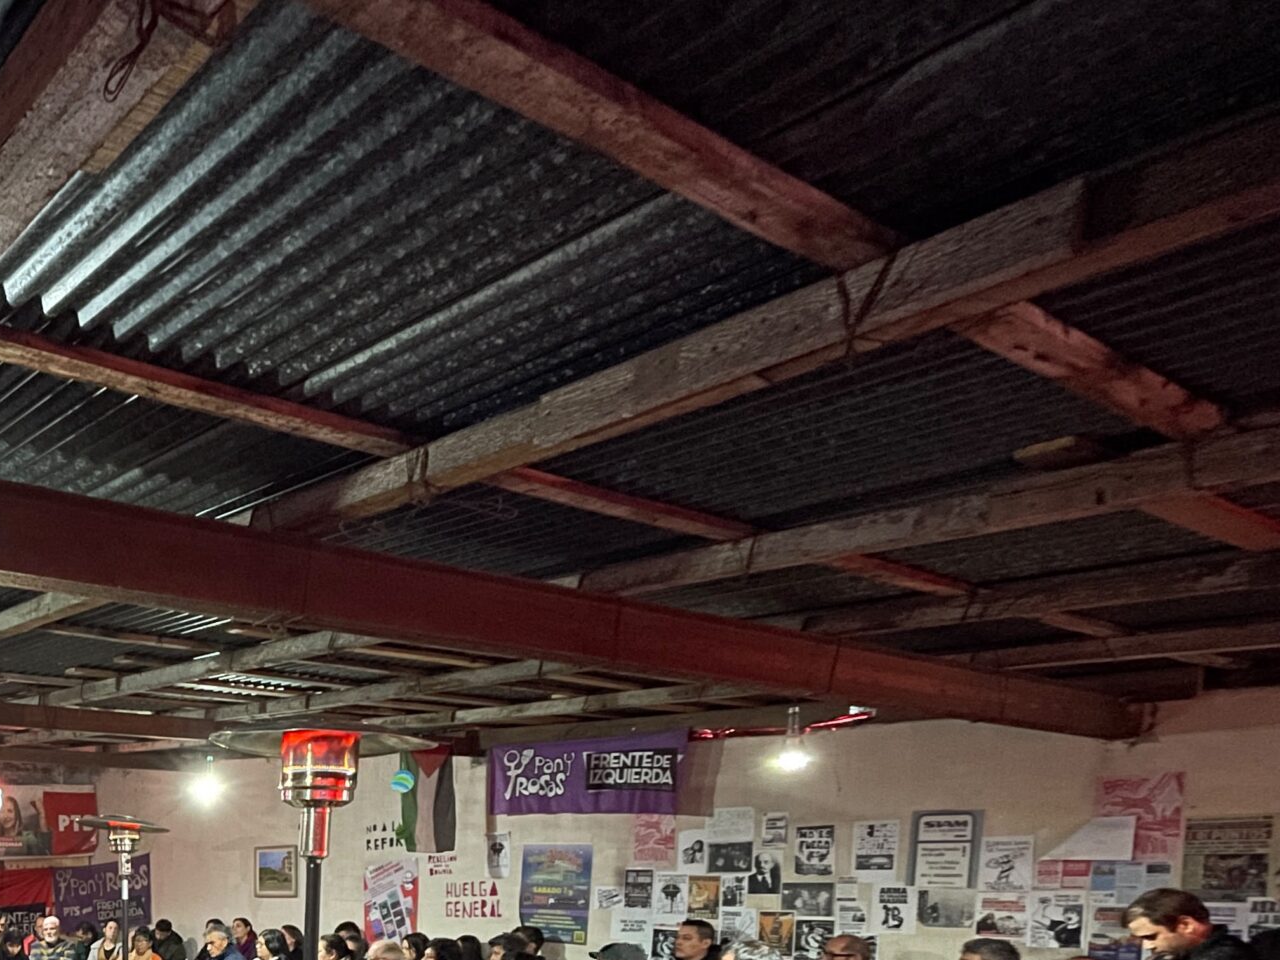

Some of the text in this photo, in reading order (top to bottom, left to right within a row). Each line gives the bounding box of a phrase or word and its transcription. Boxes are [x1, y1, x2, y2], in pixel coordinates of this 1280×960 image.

[590, 751, 673, 769] FRENTE DE
[589, 768, 673, 785] IZQUIERDA
[445, 880, 499, 898] HUELGA
[63, 905, 81, 917] PTS
[445, 899, 502, 918] GENERAL
